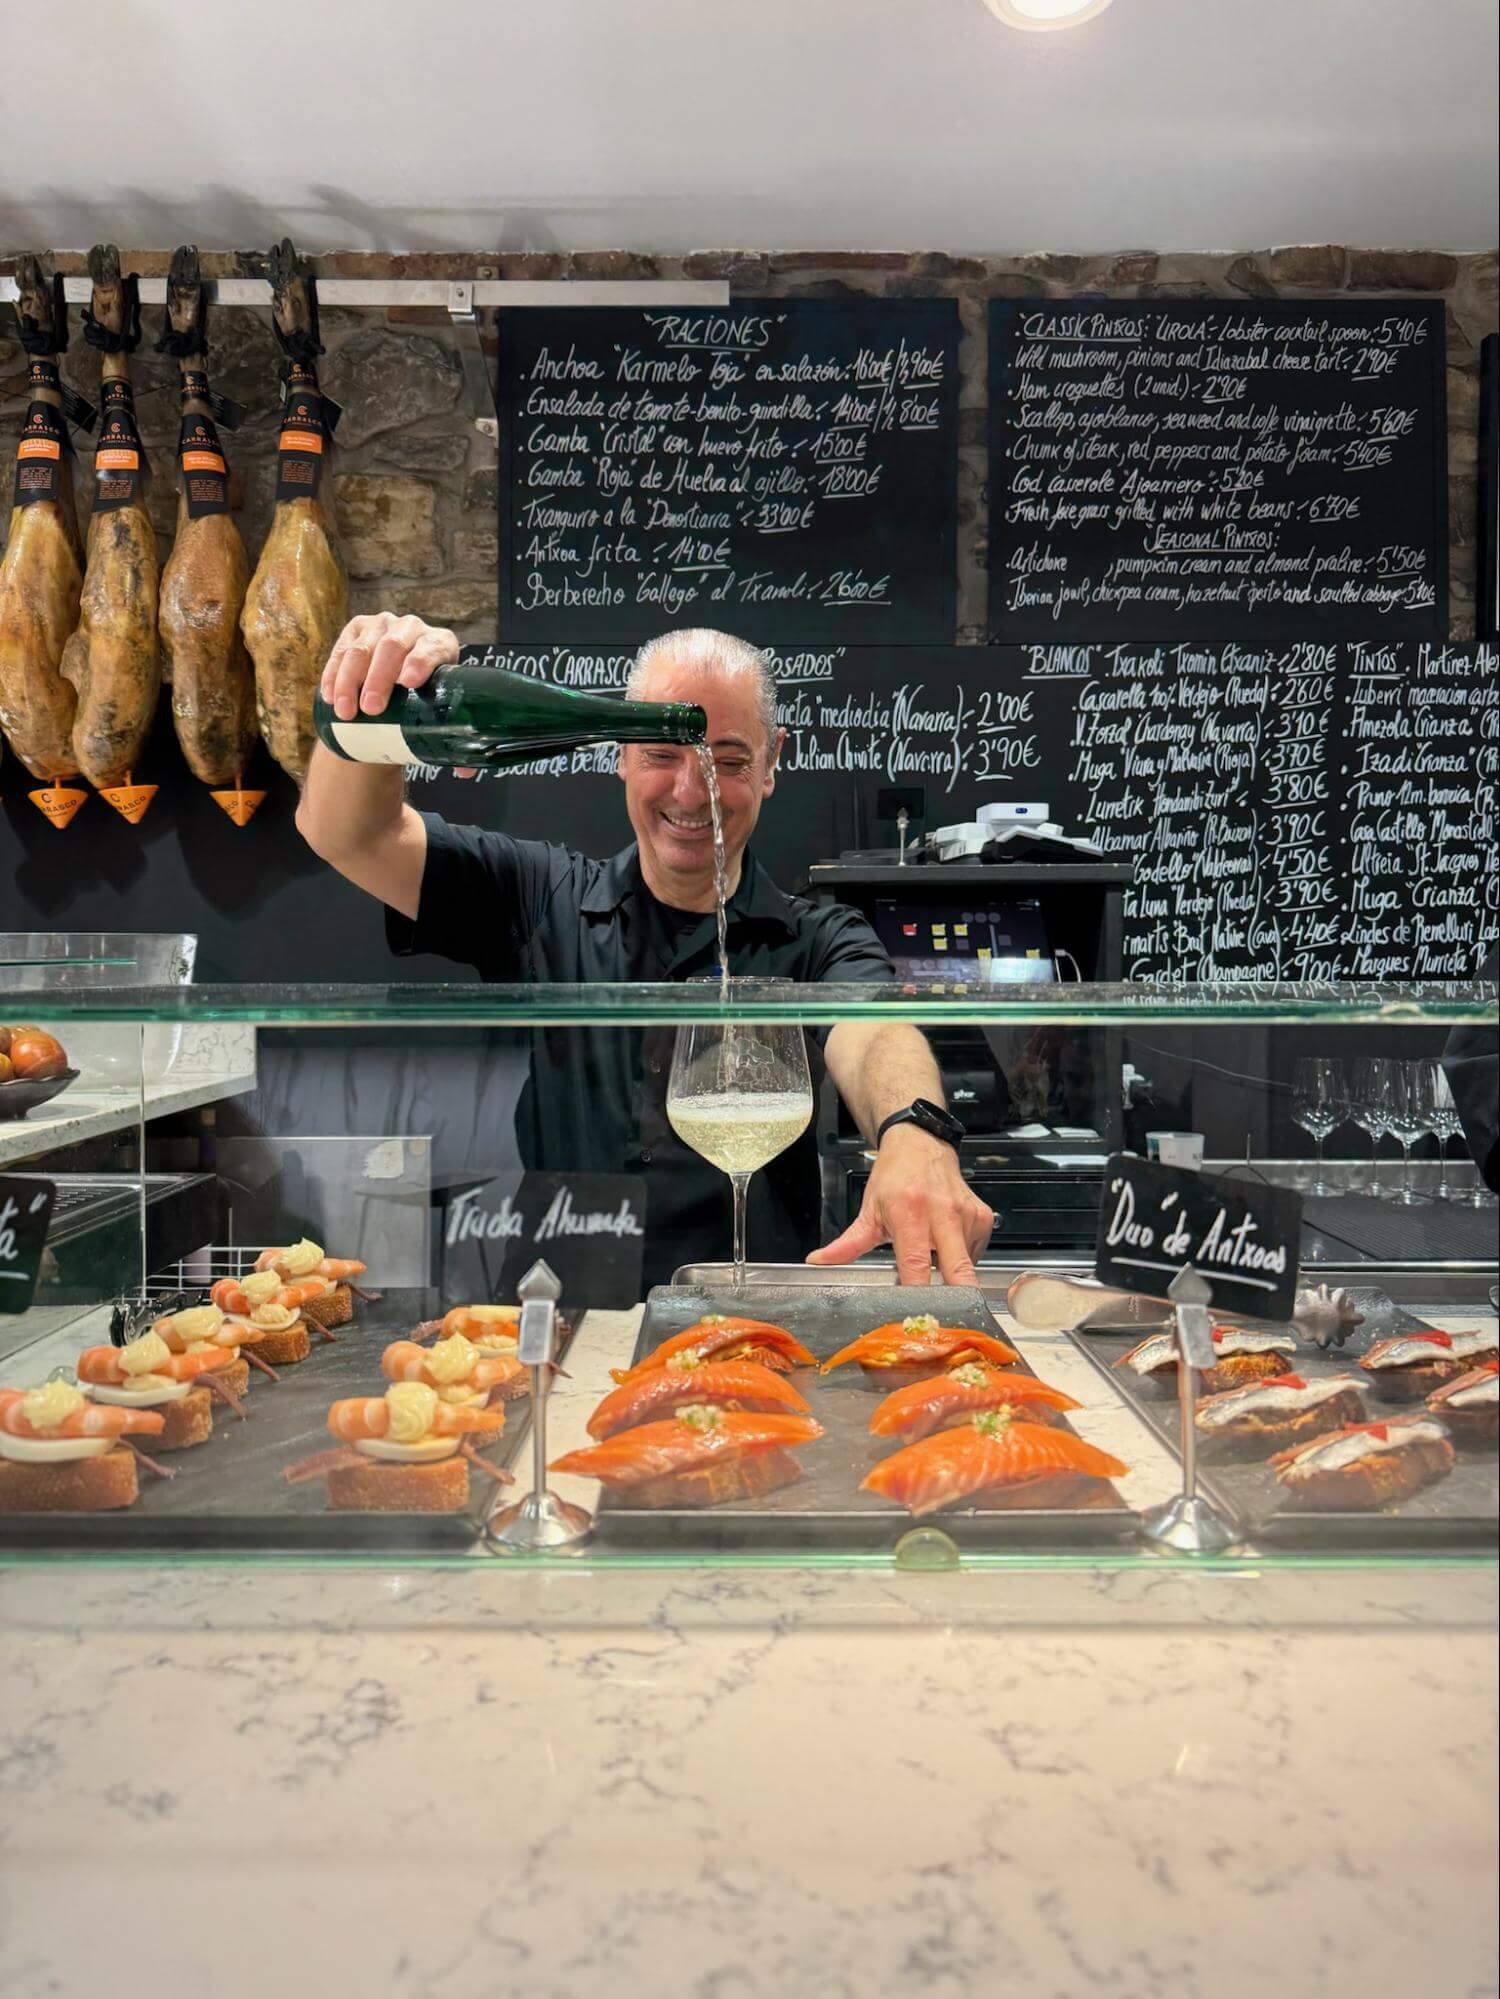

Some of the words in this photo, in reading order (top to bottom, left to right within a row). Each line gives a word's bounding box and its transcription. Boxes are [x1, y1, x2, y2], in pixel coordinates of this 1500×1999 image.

[530, 344, 605, 380] Anchoa
[1014, 344, 1046, 370] Wild
[1175, 344, 1200, 365] and
[1200, 344, 1270, 372] Idiazabal
[1271, 342, 1312, 370] cheese
[527, 386, 604, 416] Ensalada
[608, 392, 631, 420] de
[1013, 372, 1049, 401] Ham
[1053, 371, 1125, 406] croquettes
[1224, 403, 1250, 430] and
[528, 423, 590, 453] Gamba
[662, 433, 693, 453] con
[698, 425, 743, 457] huevo
[1012, 433, 1063, 462] Chunk
[1057, 439, 1078, 473] of
[1126, 434, 1151, 461] red
[1148, 444, 1209, 473] peppers
[1210, 435, 1241, 463] and
[1242, 436, 1290, 474] potato
[528, 459, 585, 487] Gamba
[640, 459, 662, 488] de
[662, 456, 726, 494] Huelva
[728, 464, 750, 492] al
[1011, 464, 1046, 494] Cod
[1047, 468, 1115, 494] casserole
[522, 493, 599, 535] Txangurro
[603, 509, 613, 527] a
[619, 496, 637, 525] la
[1005, 497, 1050, 525] Fresh
[1161, 495, 1196, 521] with
[1199, 490, 1243, 522] white
[525, 534, 580, 568] Antxoa
[1010, 540, 1068, 574] Artichoke
[1179, 559, 1222, 576] cream
[1223, 552, 1251, 575] and
[1253, 545, 1317, 575] almond
[520, 571, 625, 611] Berberecho
[711, 570, 736, 601] al
[1283, 581, 1313, 604] and
[1104, 643, 1165, 678] Txakoli
[1169, 641, 1216, 676] Txomin
[1285, 641, 1337, 674] 2'80€
[976, 690, 1035, 728] 2'00€
[1079, 680, 1147, 712] Cascarella
[1279, 676, 1336, 706] 2'60€
[1273, 707, 1332, 738] 3'10€
[1350, 705, 1412, 739] Amezola
[973, 734, 1042, 776] 3'90€
[1072, 749, 1118, 792] Muga
[1268, 737, 1327, 773] 3'70€
[1353, 741, 1412, 779] Izadi
[1261, 770, 1331, 804] 3'80€
[1349, 811, 1378, 843] Casa
[1376, 808, 1427, 845] Castillo
[1272, 845, 1334, 877] 4'50€
[1274, 877, 1339, 907] 3'90€
[1350, 874, 1403, 921] Muga
[1121, 919, 1170, 956] imarts
[1392, 916, 1412, 944] de
[1162, 1208, 1192, 1257] de
[1195, 1207, 1287, 1274] Antxoas
